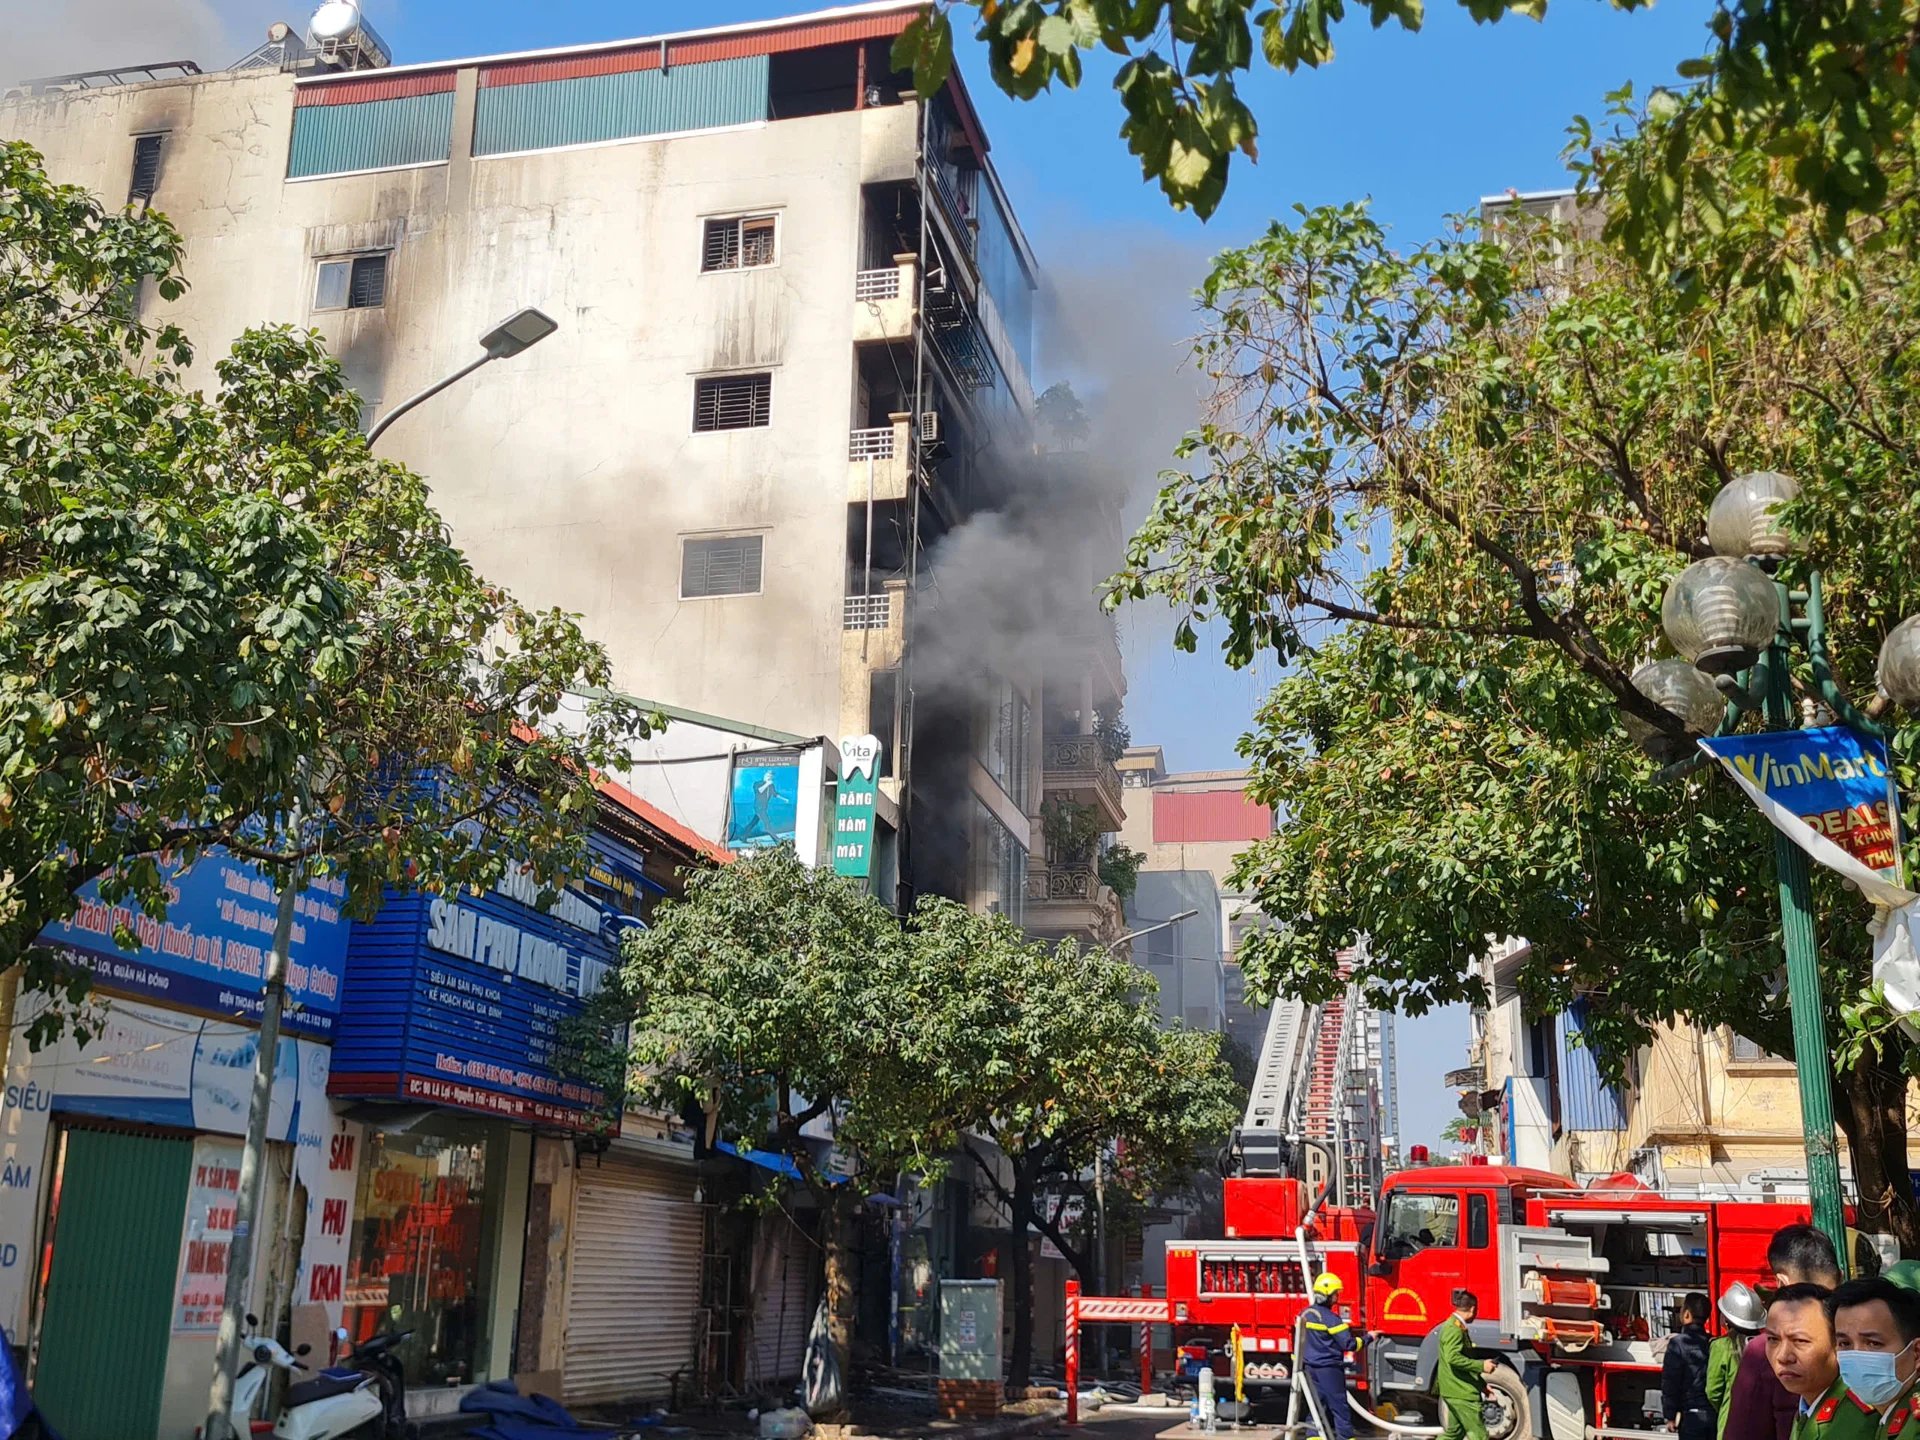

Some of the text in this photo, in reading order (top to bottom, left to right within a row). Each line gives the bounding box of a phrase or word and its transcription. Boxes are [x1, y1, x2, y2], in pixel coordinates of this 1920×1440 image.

[1721, 750, 1885, 794] WinMart
[839, 791, 873, 806] RĂNG
[837, 816, 867, 832] HÀM
[1801, 801, 1889, 836] DEALS
[836, 843, 864, 861] MẶT
[1853, 826, 1893, 847] KHỦN
[162, 922, 194, 959] thuốc
[113, 963, 136, 983] QUẬN
[136, 968, 147, 983] HÀ
[147, 974, 170, 990] ĐÔNG
[430, 970, 446, 985] SIÊU
[446, 974, 457, 989] ÂM
[485, 988, 501, 1002] KHOA
[7, 1081, 50, 1111] SIÊU
[328, 1119, 355, 1171] SẢN
[2, 1157, 31, 1188] ÂM
[321, 1197, 347, 1245] PHỤ
[310, 1264, 342, 1300] KHOA
